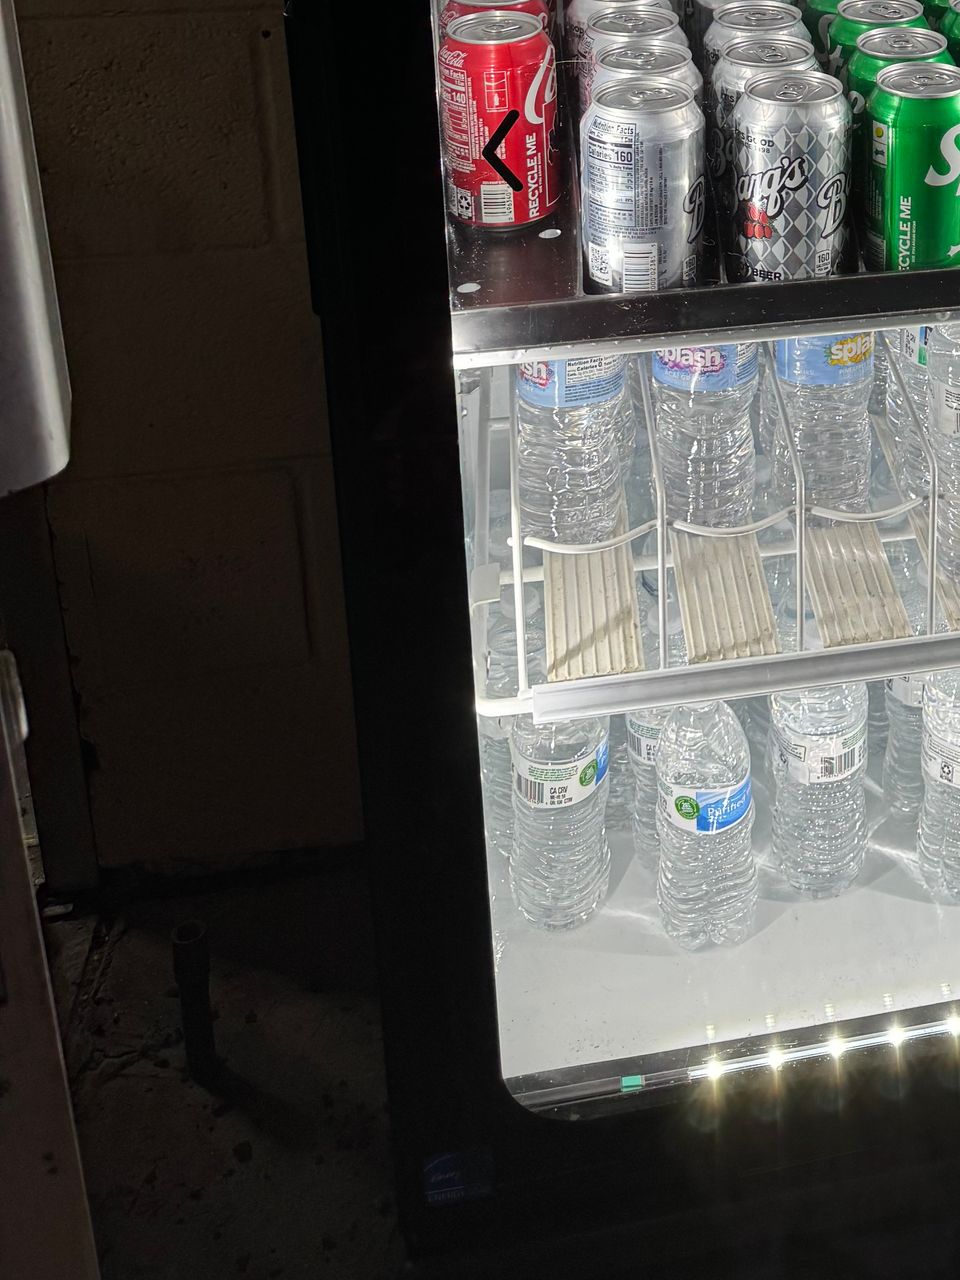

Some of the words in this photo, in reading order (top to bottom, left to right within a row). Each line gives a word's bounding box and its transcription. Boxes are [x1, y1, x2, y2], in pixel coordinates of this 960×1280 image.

[451, 91, 466, 104] 140
[525, 131, 537, 156] ME
[614, 150, 633, 163] 160
[527, 156, 540, 219] RECYCLE
[900, 196, 912, 219] ME
[752, 268, 782, 281] BEER
